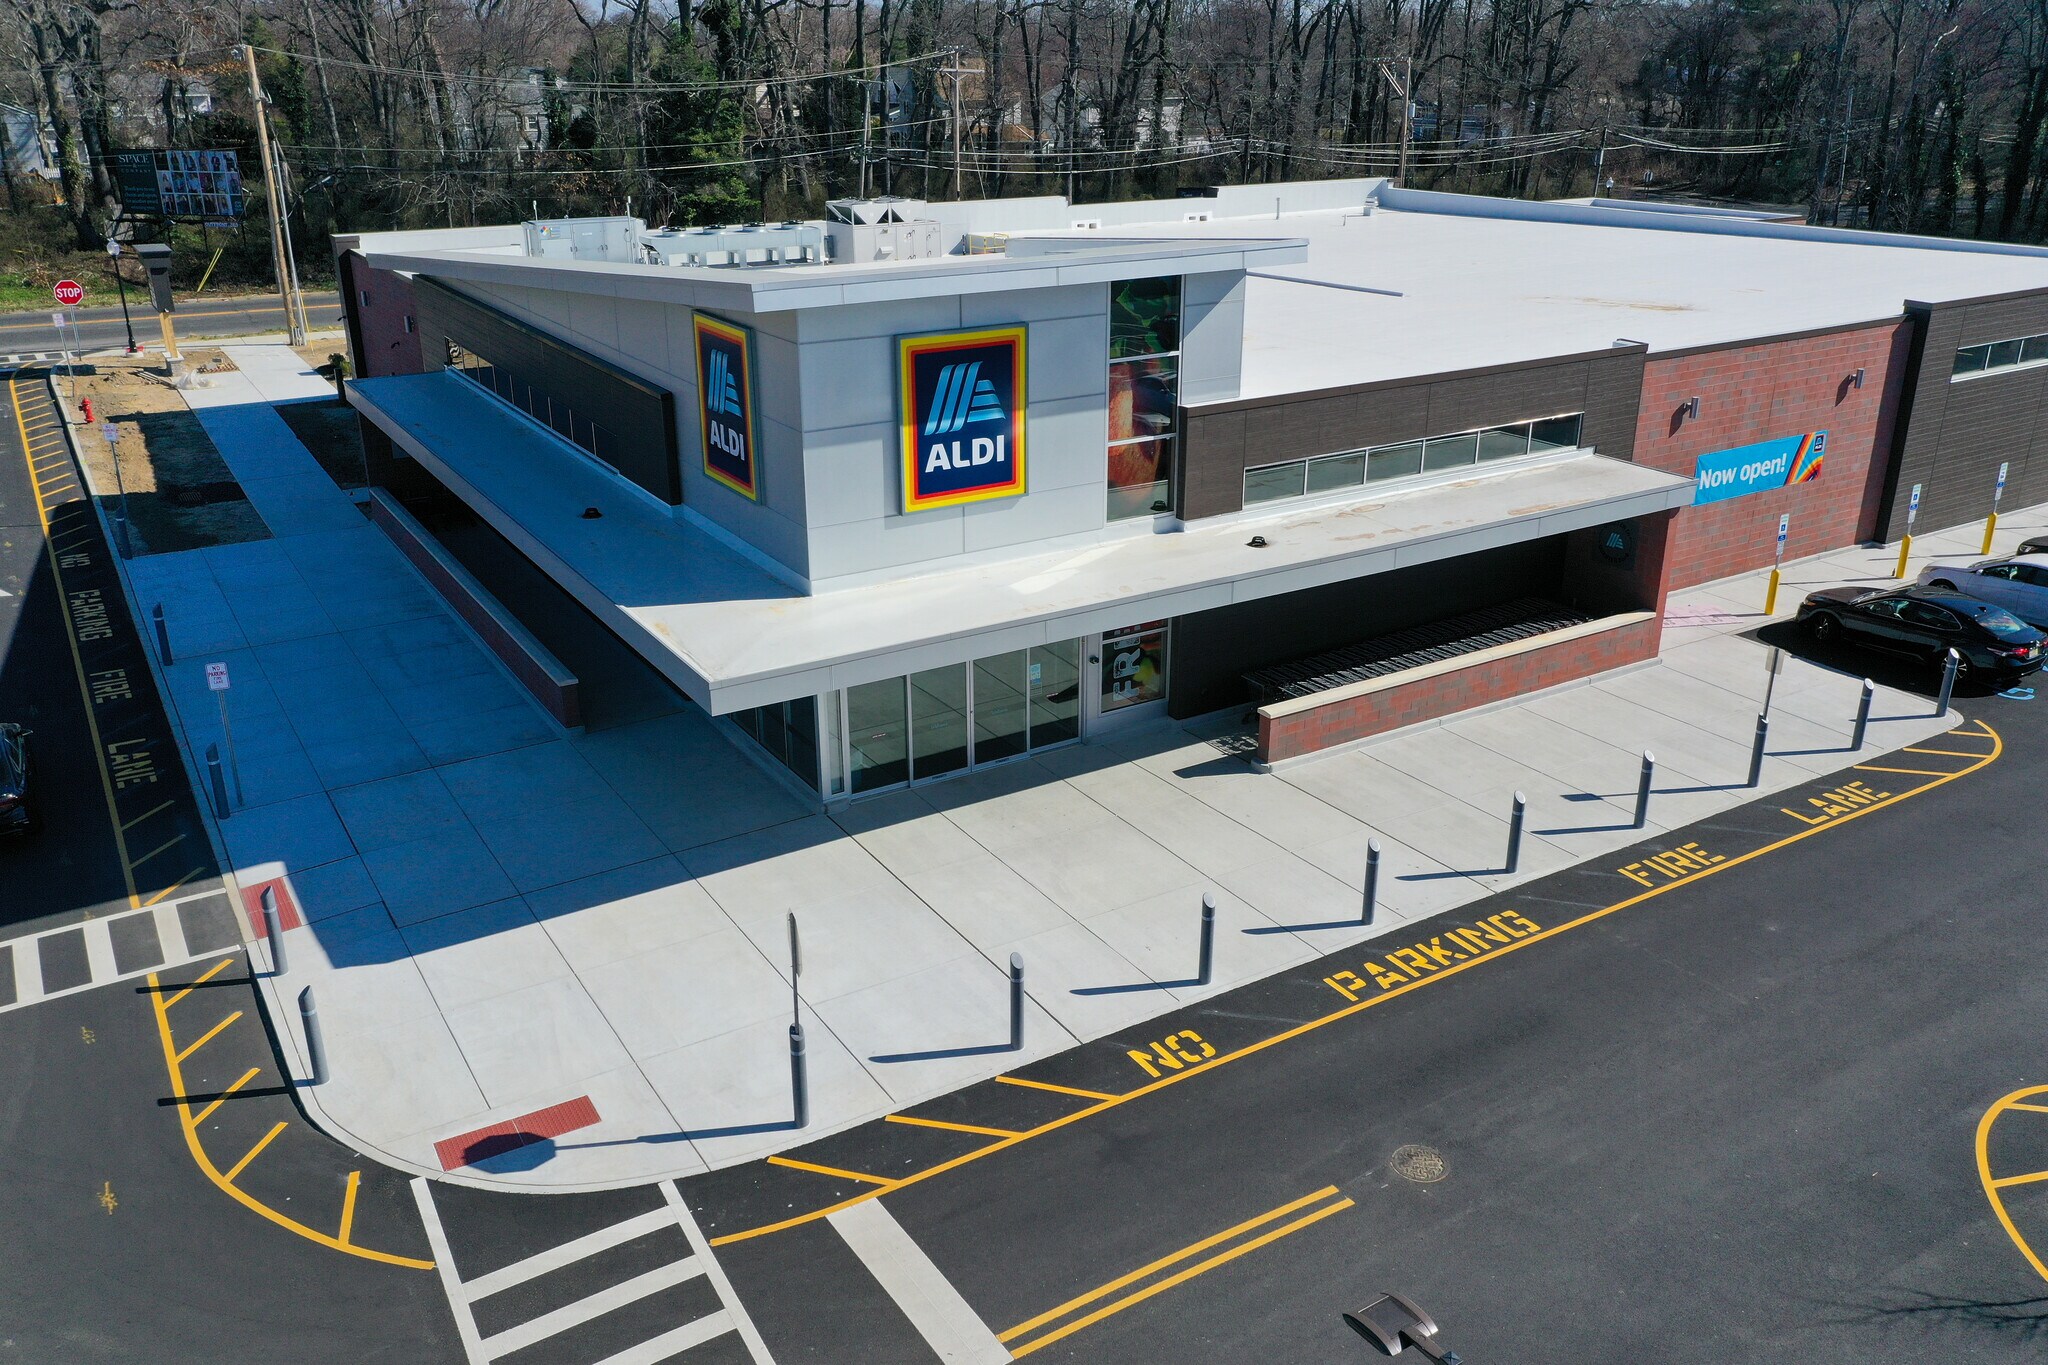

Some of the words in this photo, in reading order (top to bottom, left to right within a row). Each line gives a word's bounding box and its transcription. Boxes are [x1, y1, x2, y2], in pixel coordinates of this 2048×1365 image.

[119, 154, 149, 163] SPACE
[56, 288, 80, 298] STOP
[710, 420, 745, 461] ALDI
[925, 434, 1005, 473] ALDI
[1699, 467, 1737, 489] Now
[1740, 453, 1787, 484] open!
[60, 553, 91, 569] NO
[69, 589, 113, 641] PARKING
[90, 668, 132, 704] FIRE
[108, 738, 157, 789] LANE
[1127, 1029, 1217, 1078] NO
[1323, 910, 1541, 1001] PARKING
[1617, 842, 1726, 887] FIRE
[1781, 781, 1891, 825] LANE
